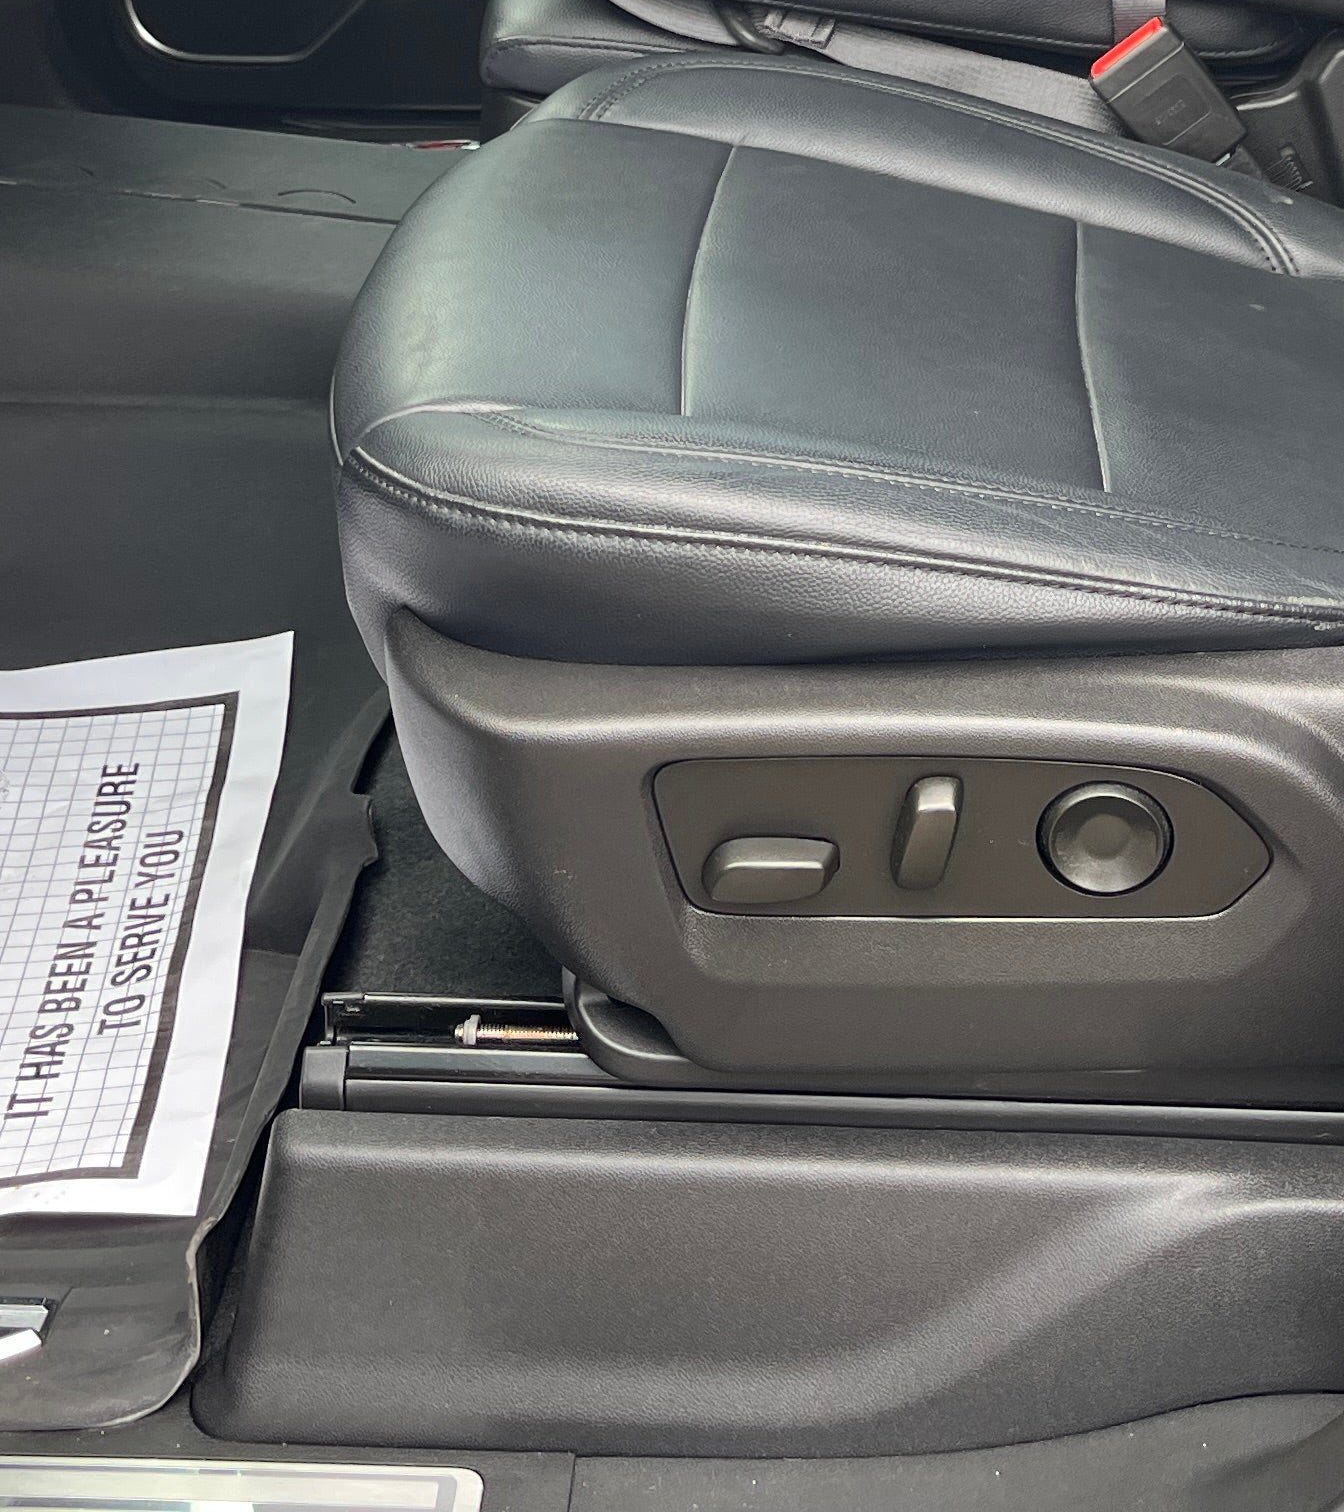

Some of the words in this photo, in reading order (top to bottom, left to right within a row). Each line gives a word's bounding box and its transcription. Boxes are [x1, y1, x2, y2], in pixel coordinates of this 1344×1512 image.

[69, 762, 140, 905] PLEASURE
[134, 829, 185, 888] YOU
[62, 910, 105, 931] A
[110, 892, 171, 990] SERVE
[37, 940, 98, 1014] BEEN
[97, 994, 146, 1036] TO
[15, 1022, 75, 1082] HAS
[4, 1093, 54, 1121] IT
